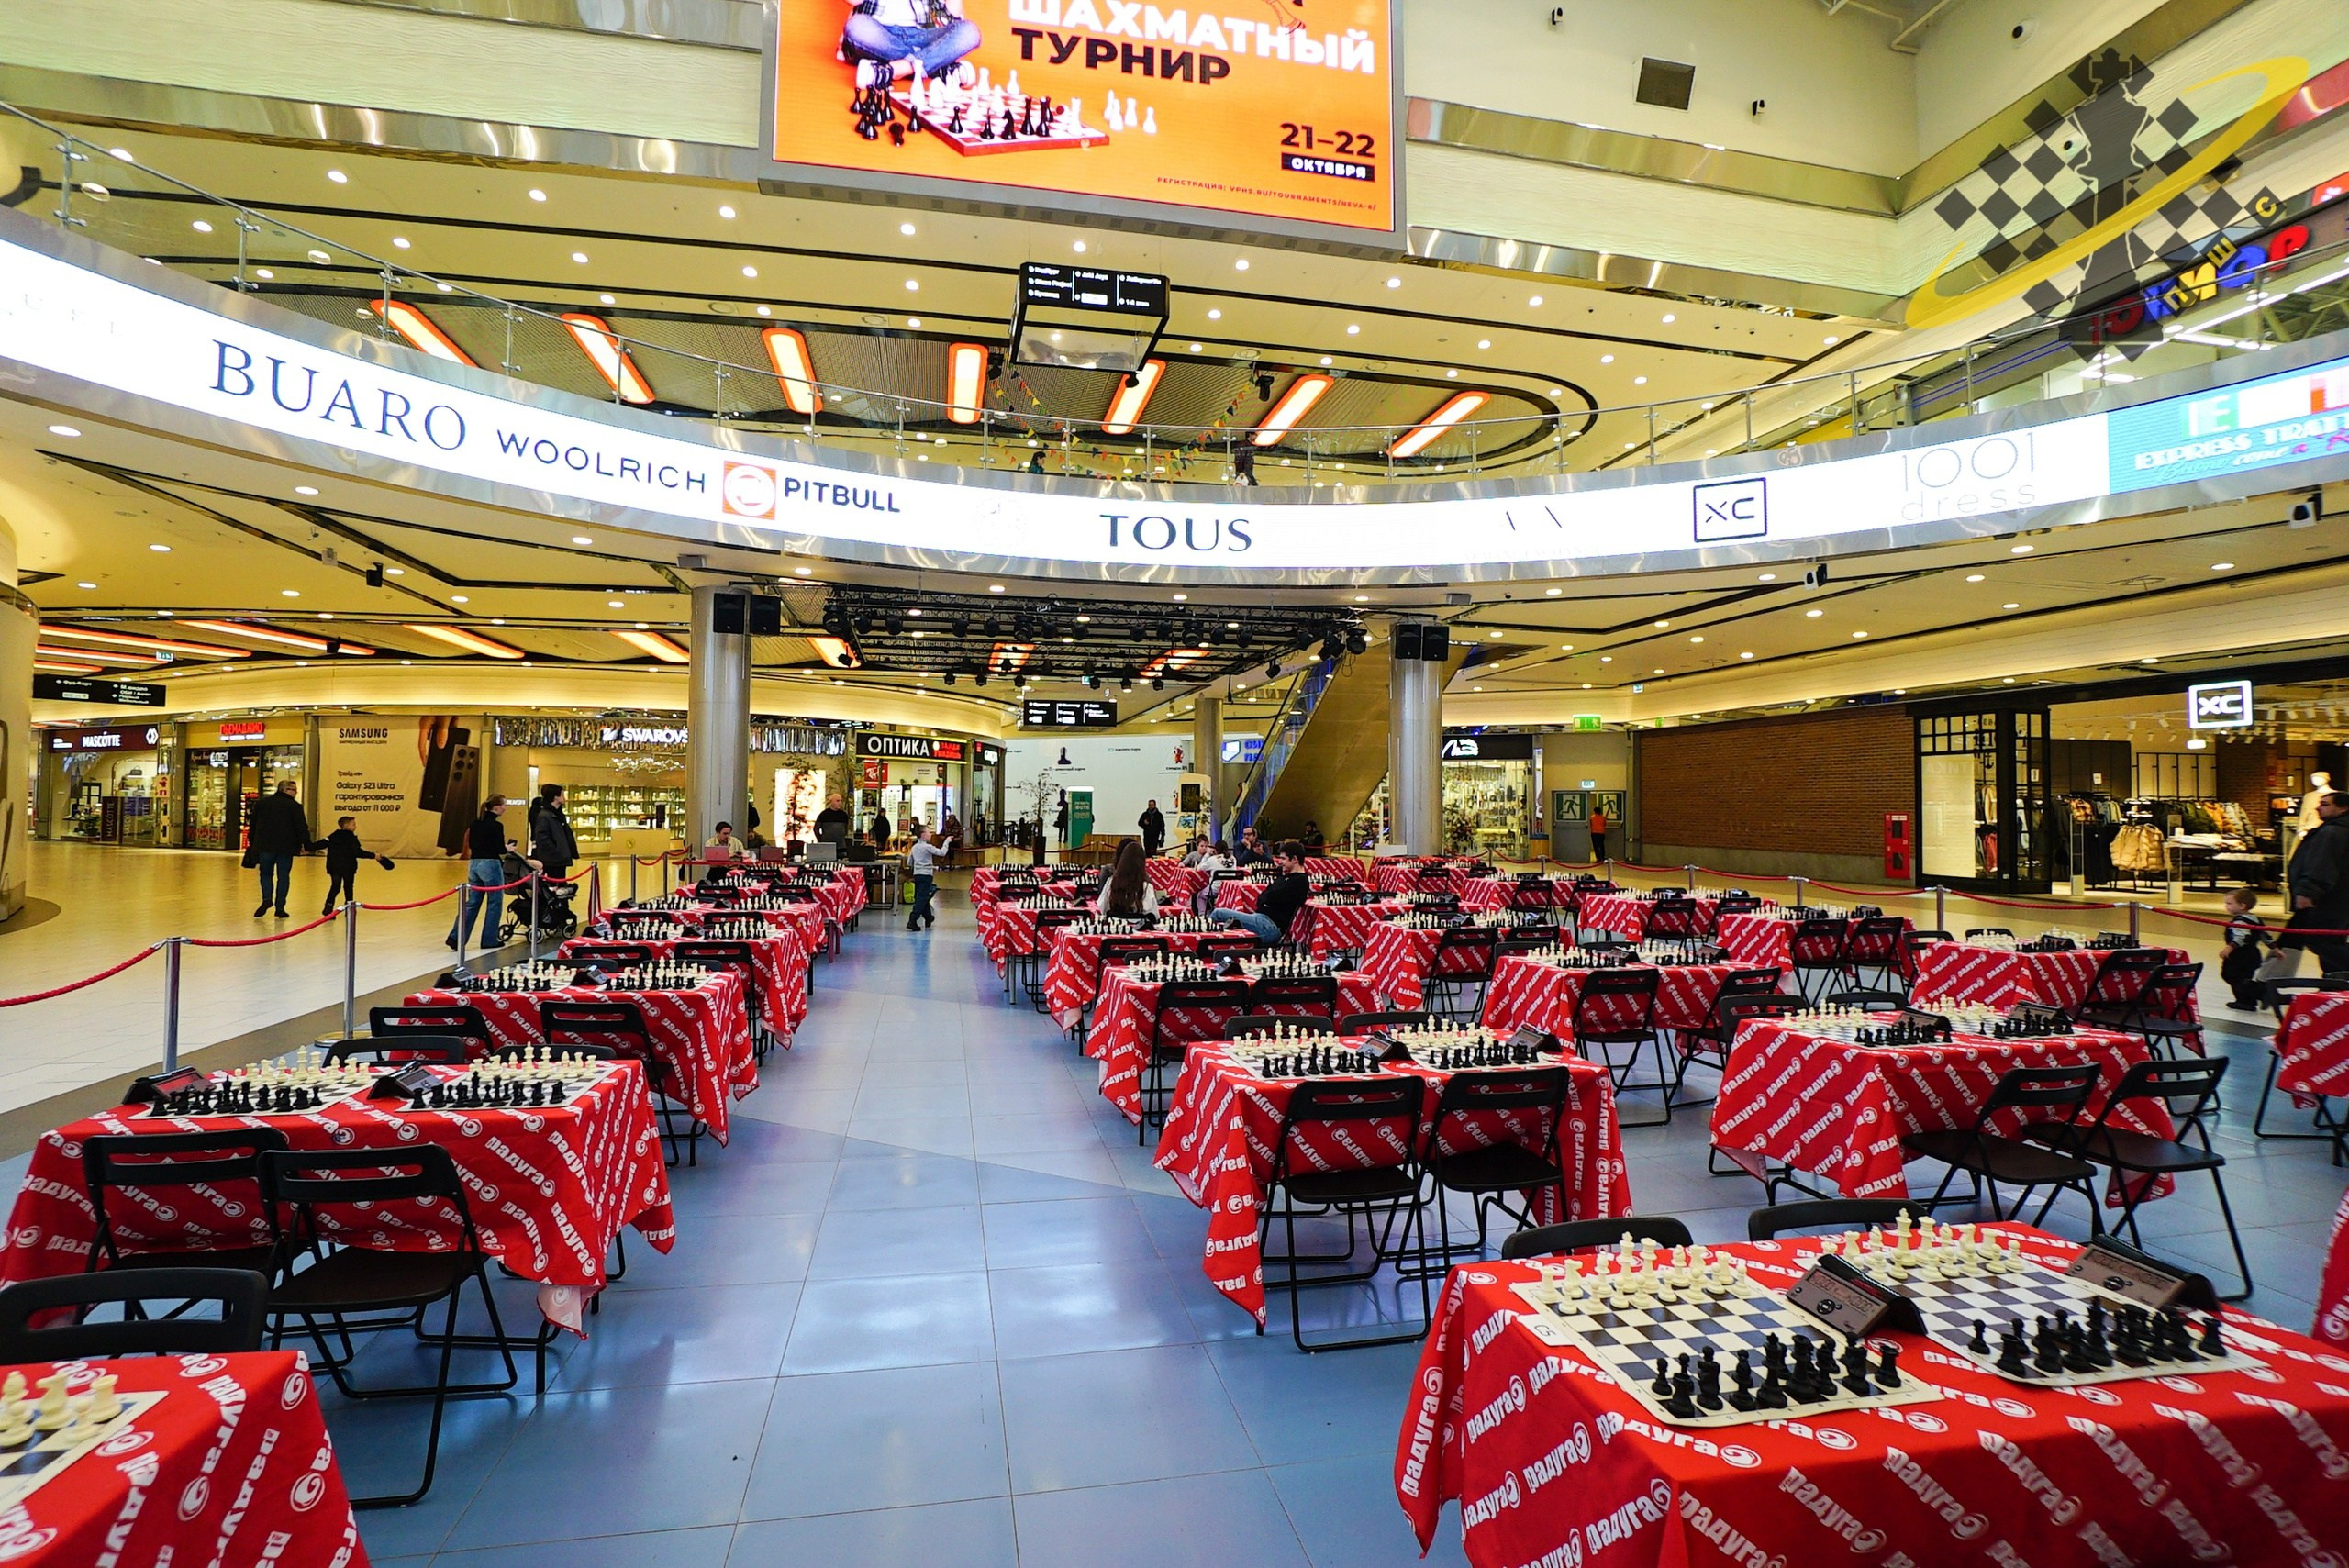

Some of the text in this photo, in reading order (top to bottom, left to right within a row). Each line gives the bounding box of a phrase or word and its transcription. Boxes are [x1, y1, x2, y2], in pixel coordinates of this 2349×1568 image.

[1009, 0, 1375, 73] ШАХМАТНЫЙ
[1010, 28, 1230, 85] ТУРНИР
[1157, 177, 1228, 192] РЕГИСТРАЦИЯ:
[1291, 158, 1366, 179] ОКТЯБРЯ
[212, 339, 466, 450] BUARO
[496, 428, 706, 494] WOOLRICH
[1902, 432, 2034, 492] 1001
[2134, 434, 2253, 470] EXPRESS
[784, 476, 901, 513] PITBULL
[1902, 484, 2035, 520] dress
[1099, 514, 1252, 552] TOUS
[2197, 691, 2243, 716] XC
[339, 728, 388, 738] SAMSUNG
[867, 736, 930, 757] ОПТИКА
[336, 782, 362, 791] Galaxy
[363, 782, 375, 790] S23
[1722, 1061, 1760, 1095] радуга
[1766, 1063, 1795, 1098] радуга
[1800, 1068, 1834, 1102] радуга
[1598, 1089, 1611, 1151] радуга
[1719, 1103, 1759, 1135] радуга
[1766, 1106, 1796, 1139] радуга
[1800, 1112, 1834, 1144] радуга
[485, 1136, 545, 1187] радуга
[548, 1131, 591, 1191] радуга
[1573, 1133, 1586, 1192] радуга
[501, 1202, 544, 1255] радуга
[551, 1202, 592, 1262] радуга
[1472, 1309, 1520, 1355] радуг
[1466, 1391, 1515, 1444] радуга
[1596, 1410, 1720, 1459] радуга
[1400, 1395, 1440, 1498] радуга
[1523, 1438, 1579, 1494] радуга
[1977, 1429, 2064, 1511] радуга
[1778, 1466, 1864, 1541] радуга
[1882, 1445, 1965, 1524] радуга
[1586, 1495, 1664, 1555] радуга
[1678, 1491, 1774, 1568] радуга
